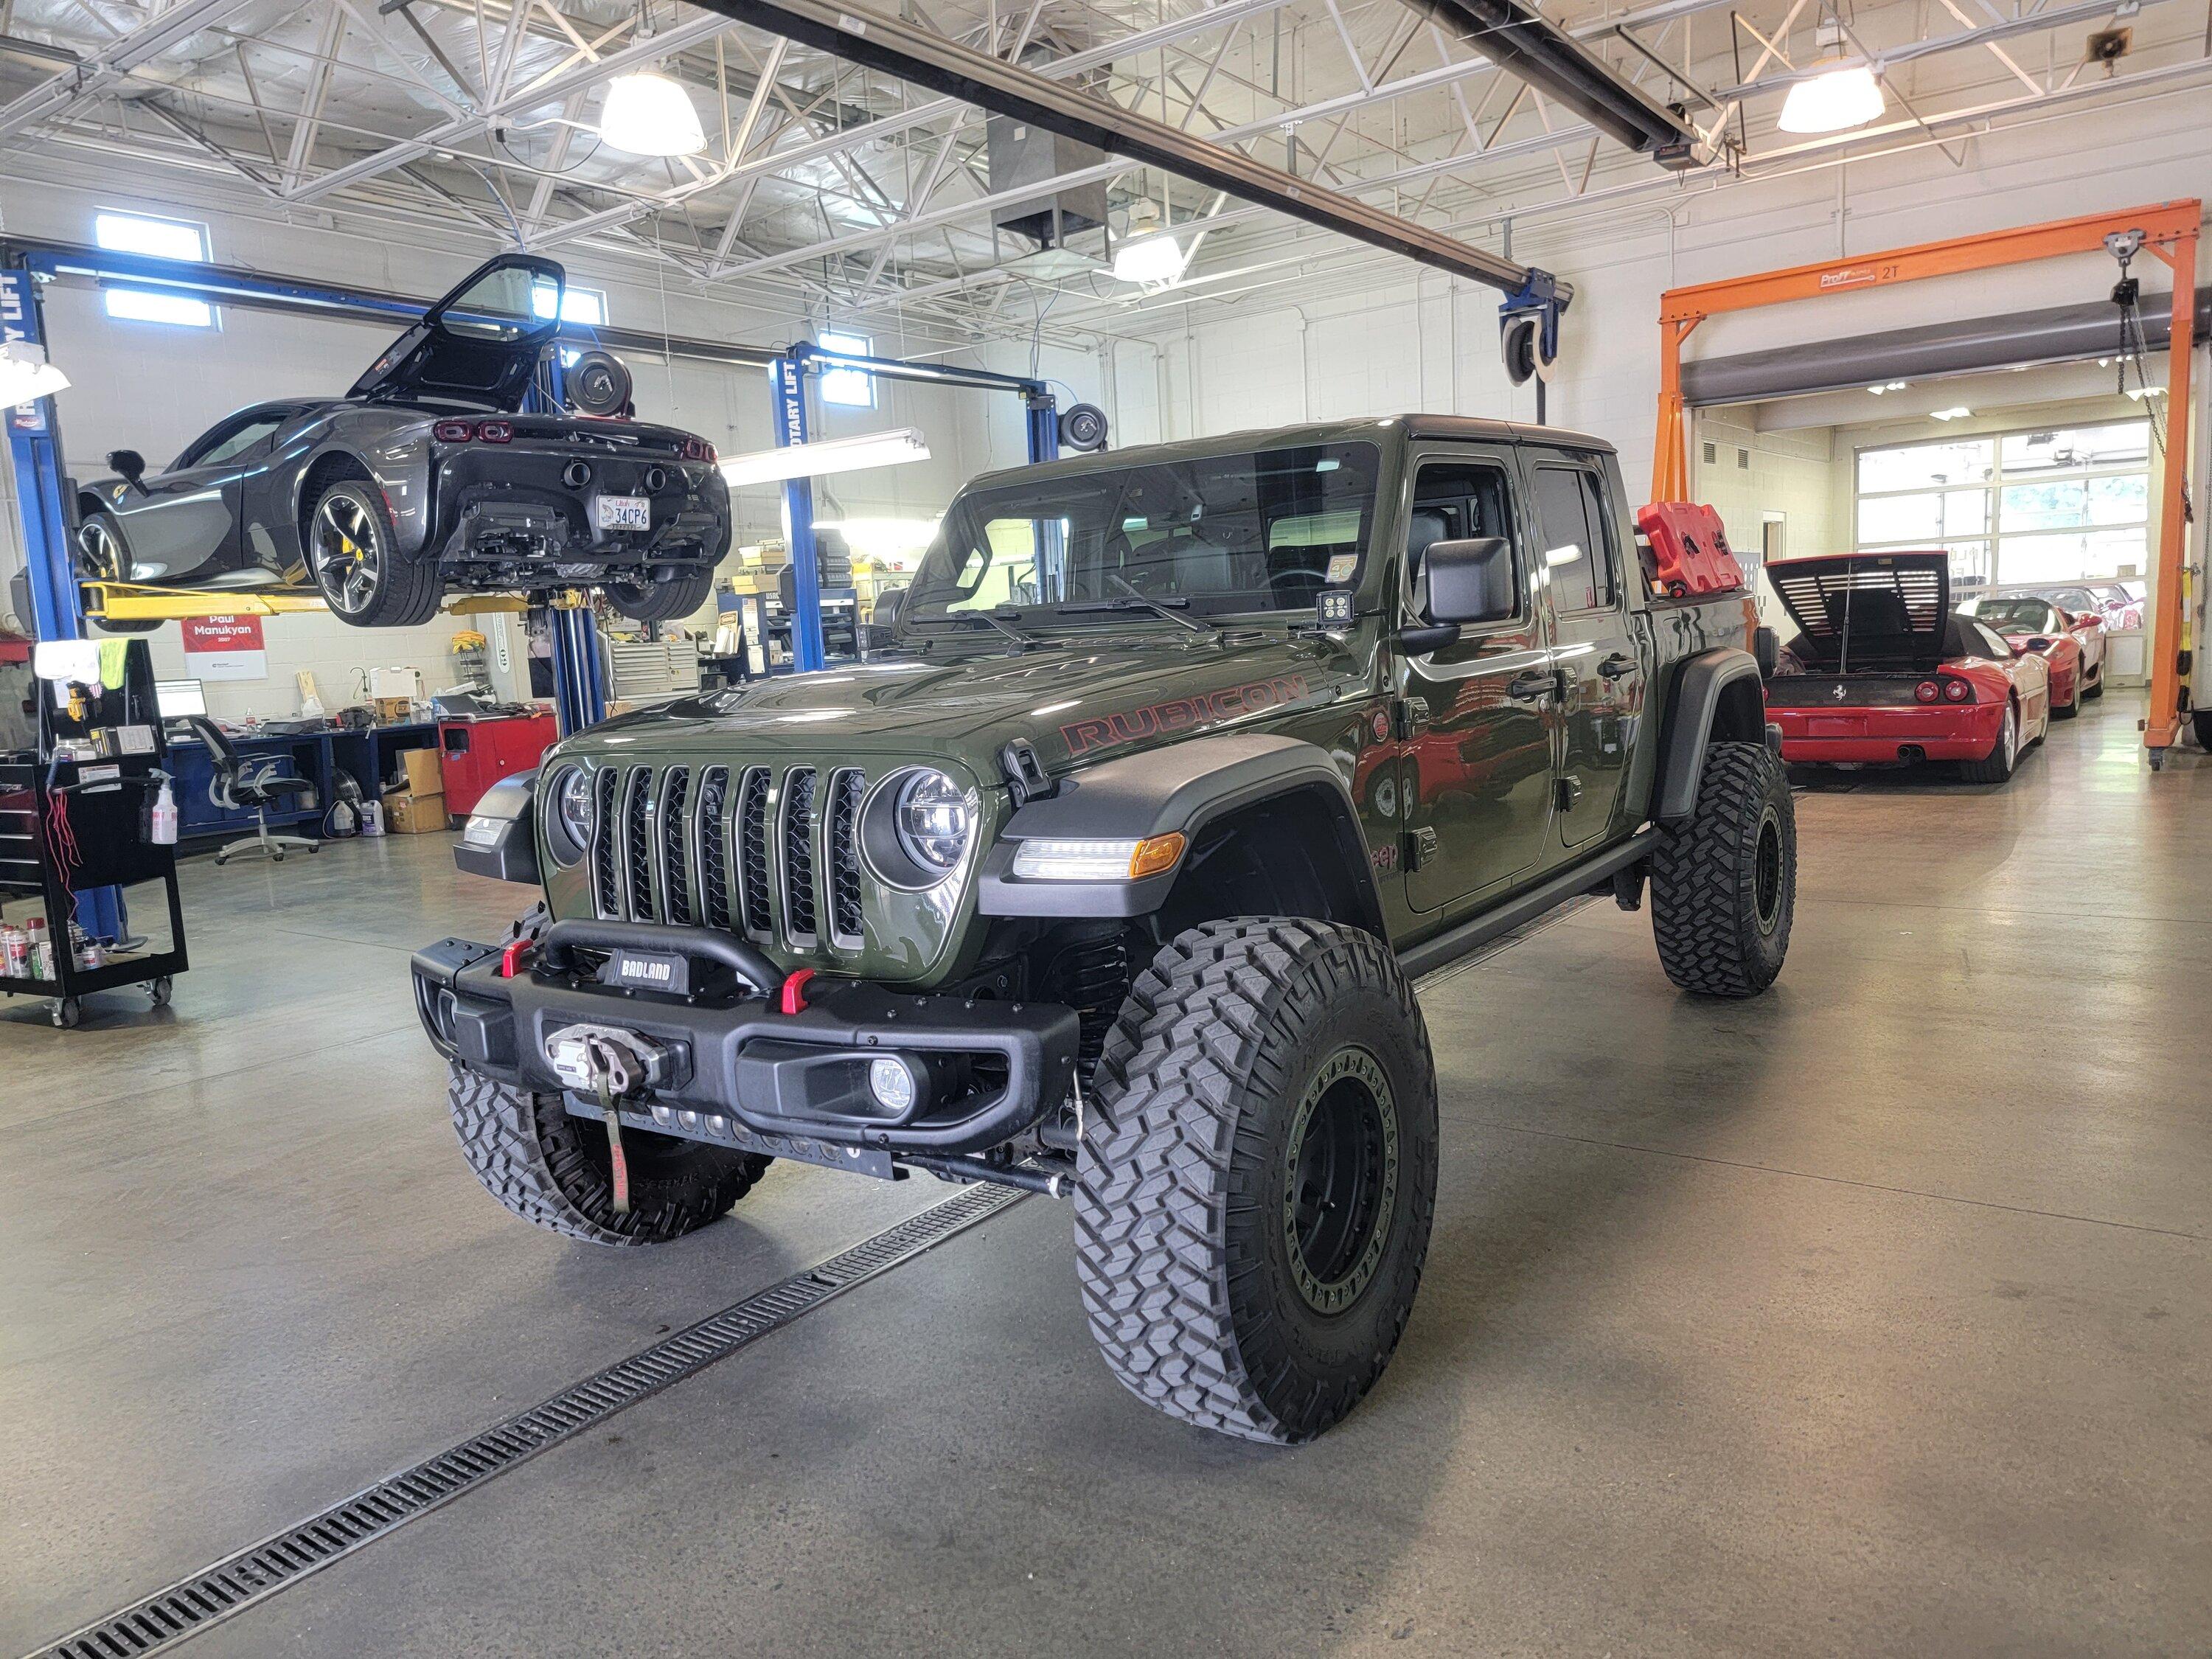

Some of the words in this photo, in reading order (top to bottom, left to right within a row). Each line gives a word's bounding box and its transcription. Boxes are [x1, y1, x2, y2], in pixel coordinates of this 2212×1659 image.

[1882, 265, 1899, 279] 2T
[783, 361, 798, 394] LIFT
[786, 399, 802, 448] OTARY
[615, 508, 647, 524] 34CP6
[209, 615, 234, 624] Paul
[194, 625, 251, 636] Manukyan
[1060, 675, 1310, 754] RUBICON
[1371, 844, 1399, 870] eep
[622, 960, 670, 981] BADLAND
